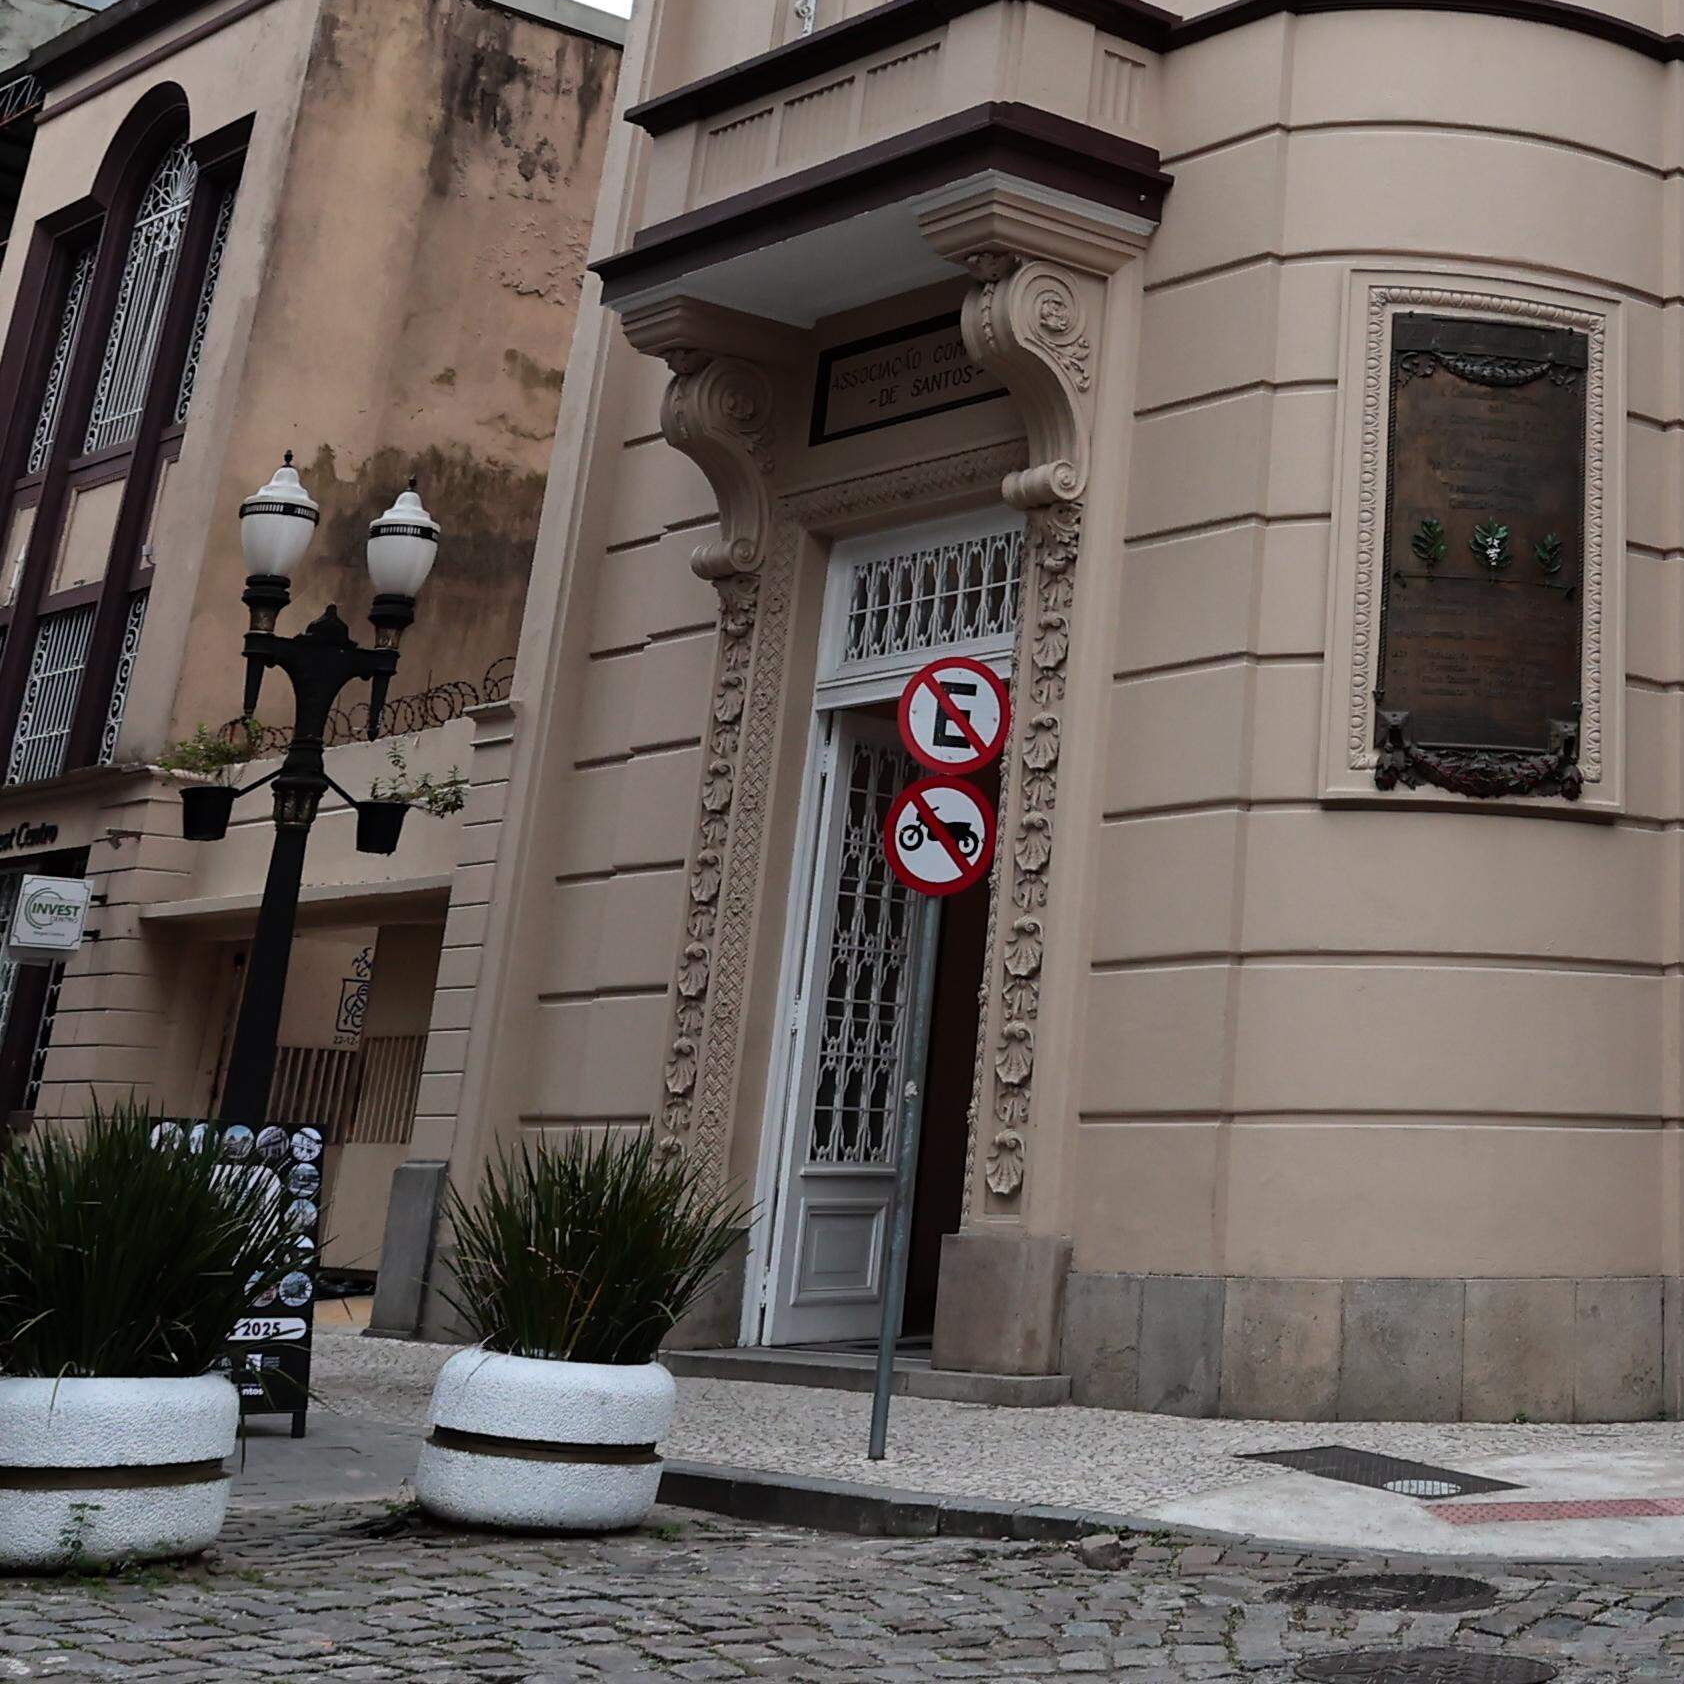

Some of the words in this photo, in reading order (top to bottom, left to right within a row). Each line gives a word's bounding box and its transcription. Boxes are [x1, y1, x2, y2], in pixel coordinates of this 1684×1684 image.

[933, 680, 977, 749] E
[31, 902, 81, 917] INVEST
[243, 1321, 282, 1337] 2025
